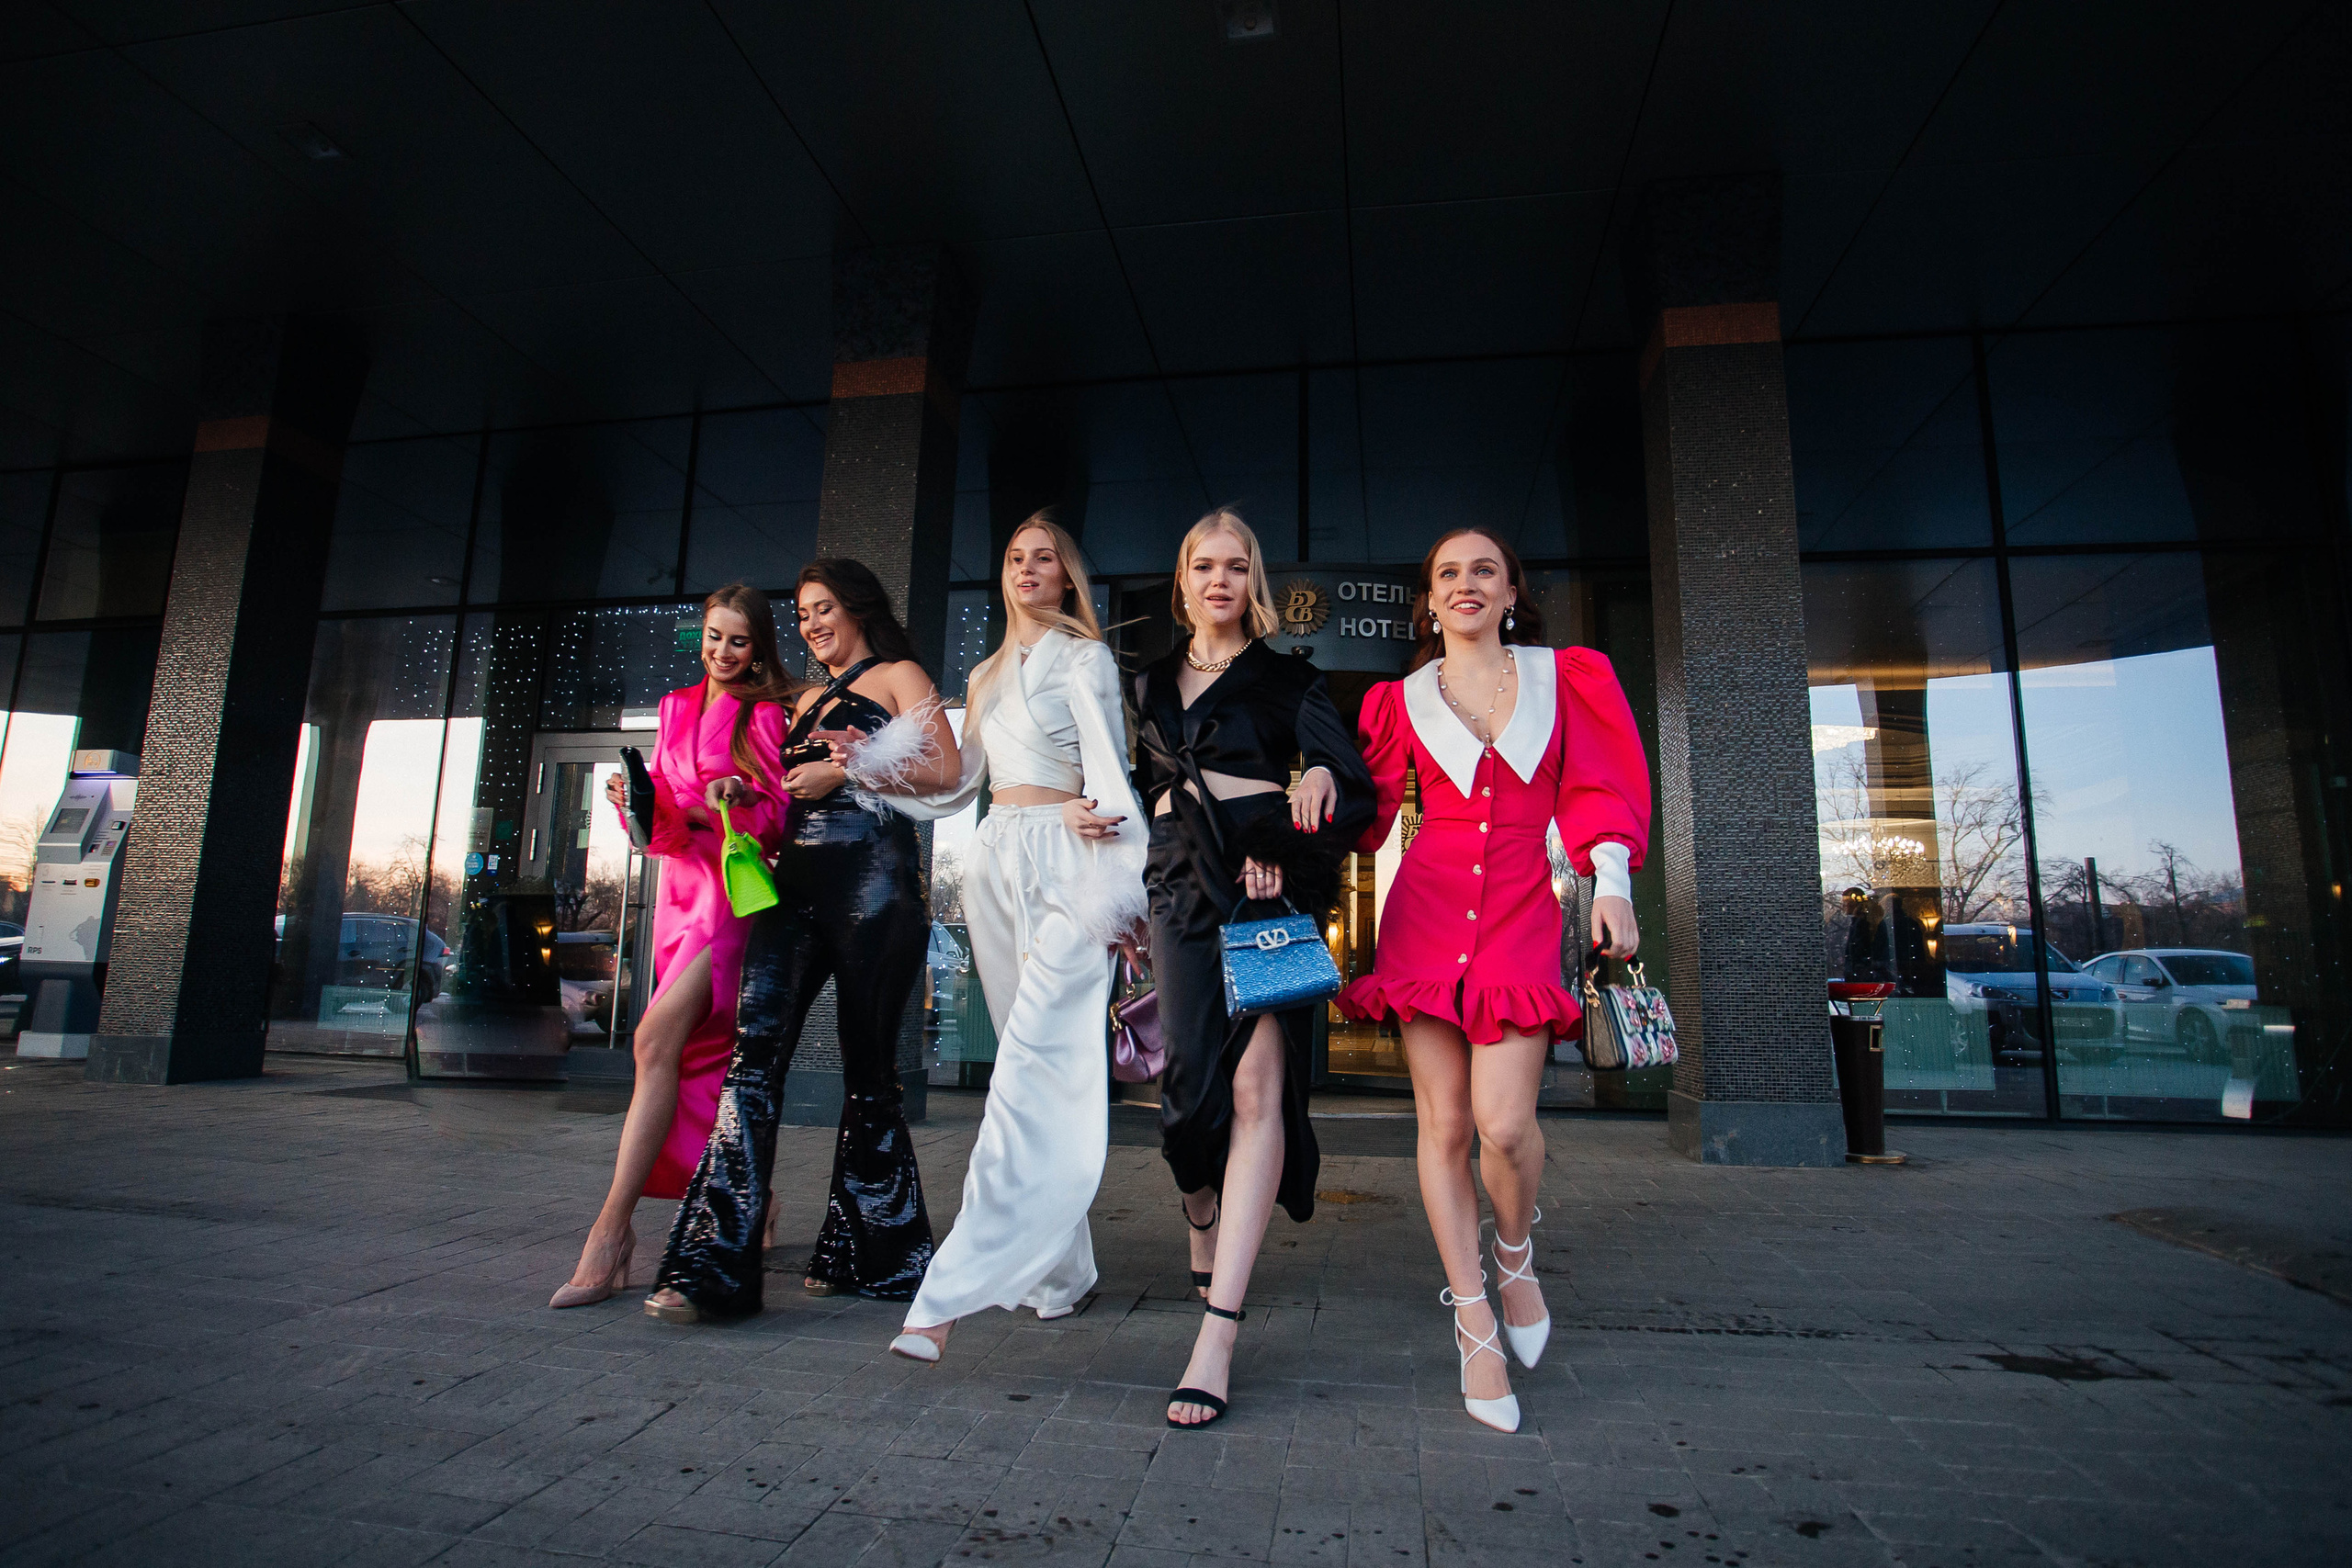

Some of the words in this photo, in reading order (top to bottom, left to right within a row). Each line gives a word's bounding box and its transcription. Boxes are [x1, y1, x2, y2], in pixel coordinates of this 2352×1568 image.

[1338, 581, 1416, 605] ОТЕЛЬ
[1340, 617, 1416, 640] HOTEL
[28, 946, 42, 954] RPS
